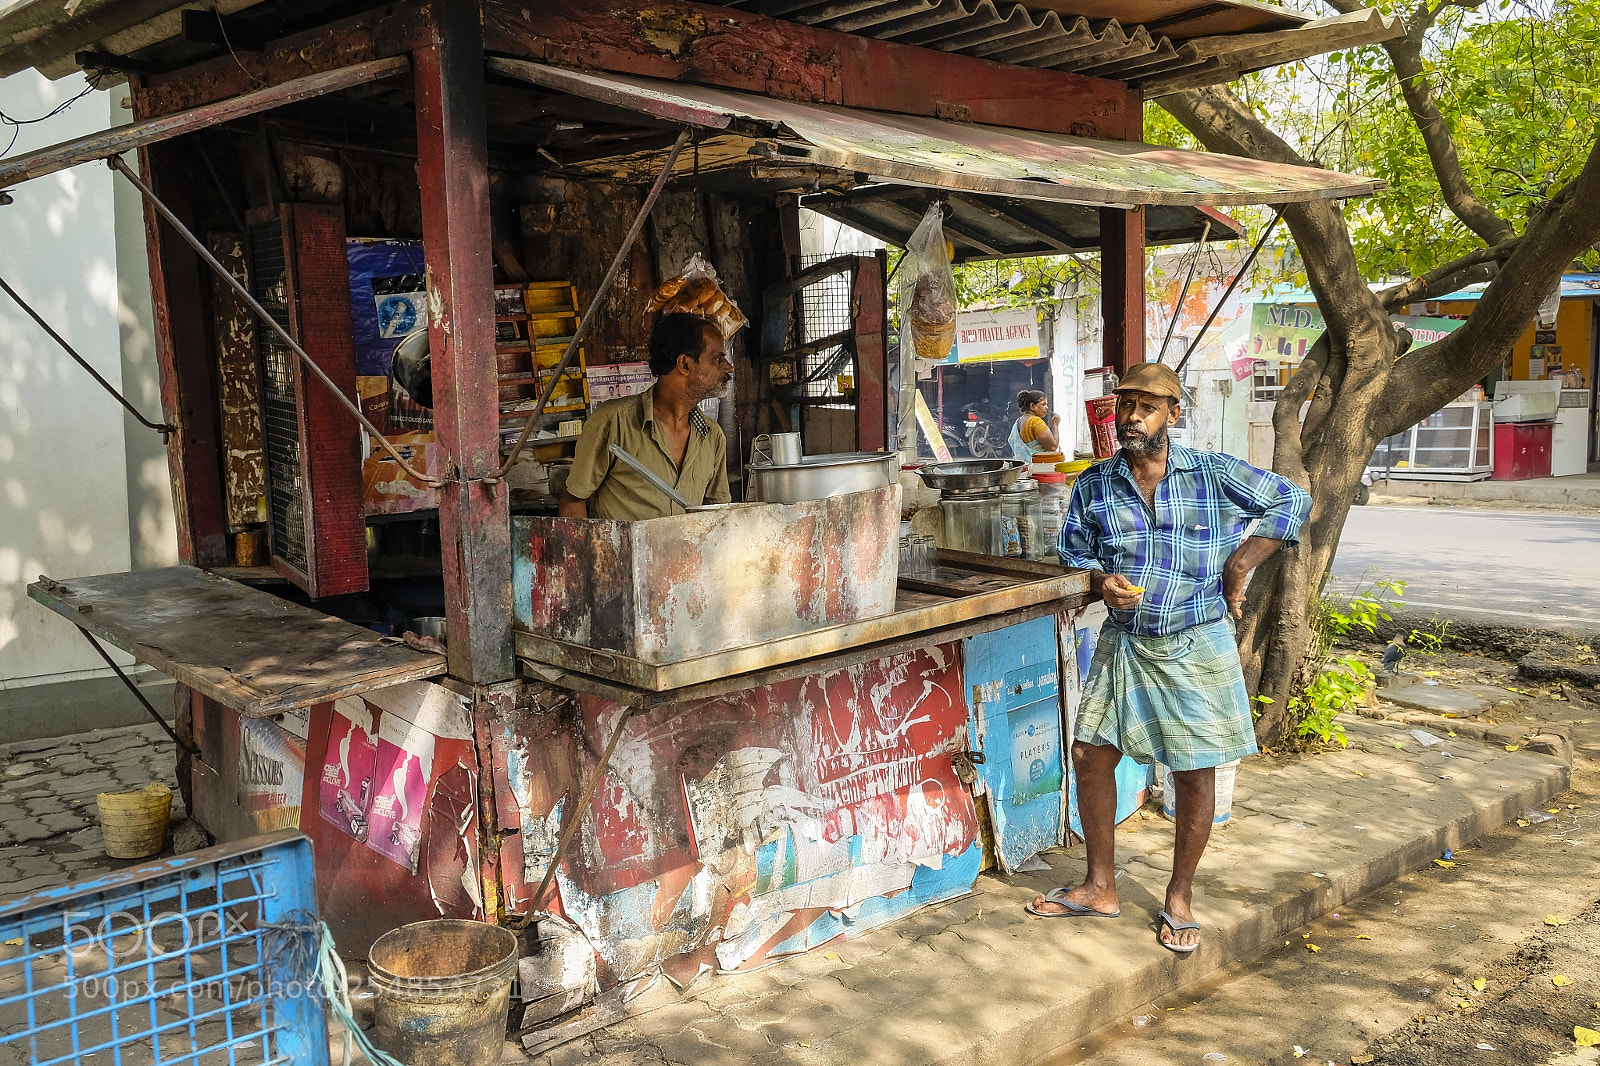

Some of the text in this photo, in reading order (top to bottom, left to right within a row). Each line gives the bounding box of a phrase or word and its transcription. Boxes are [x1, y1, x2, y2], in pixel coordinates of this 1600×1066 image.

[978, 326, 1005, 343] TRAVEL
[1005, 324, 1031, 341] AGENCY
[1020, 741, 1050, 760] PLAYER'S
